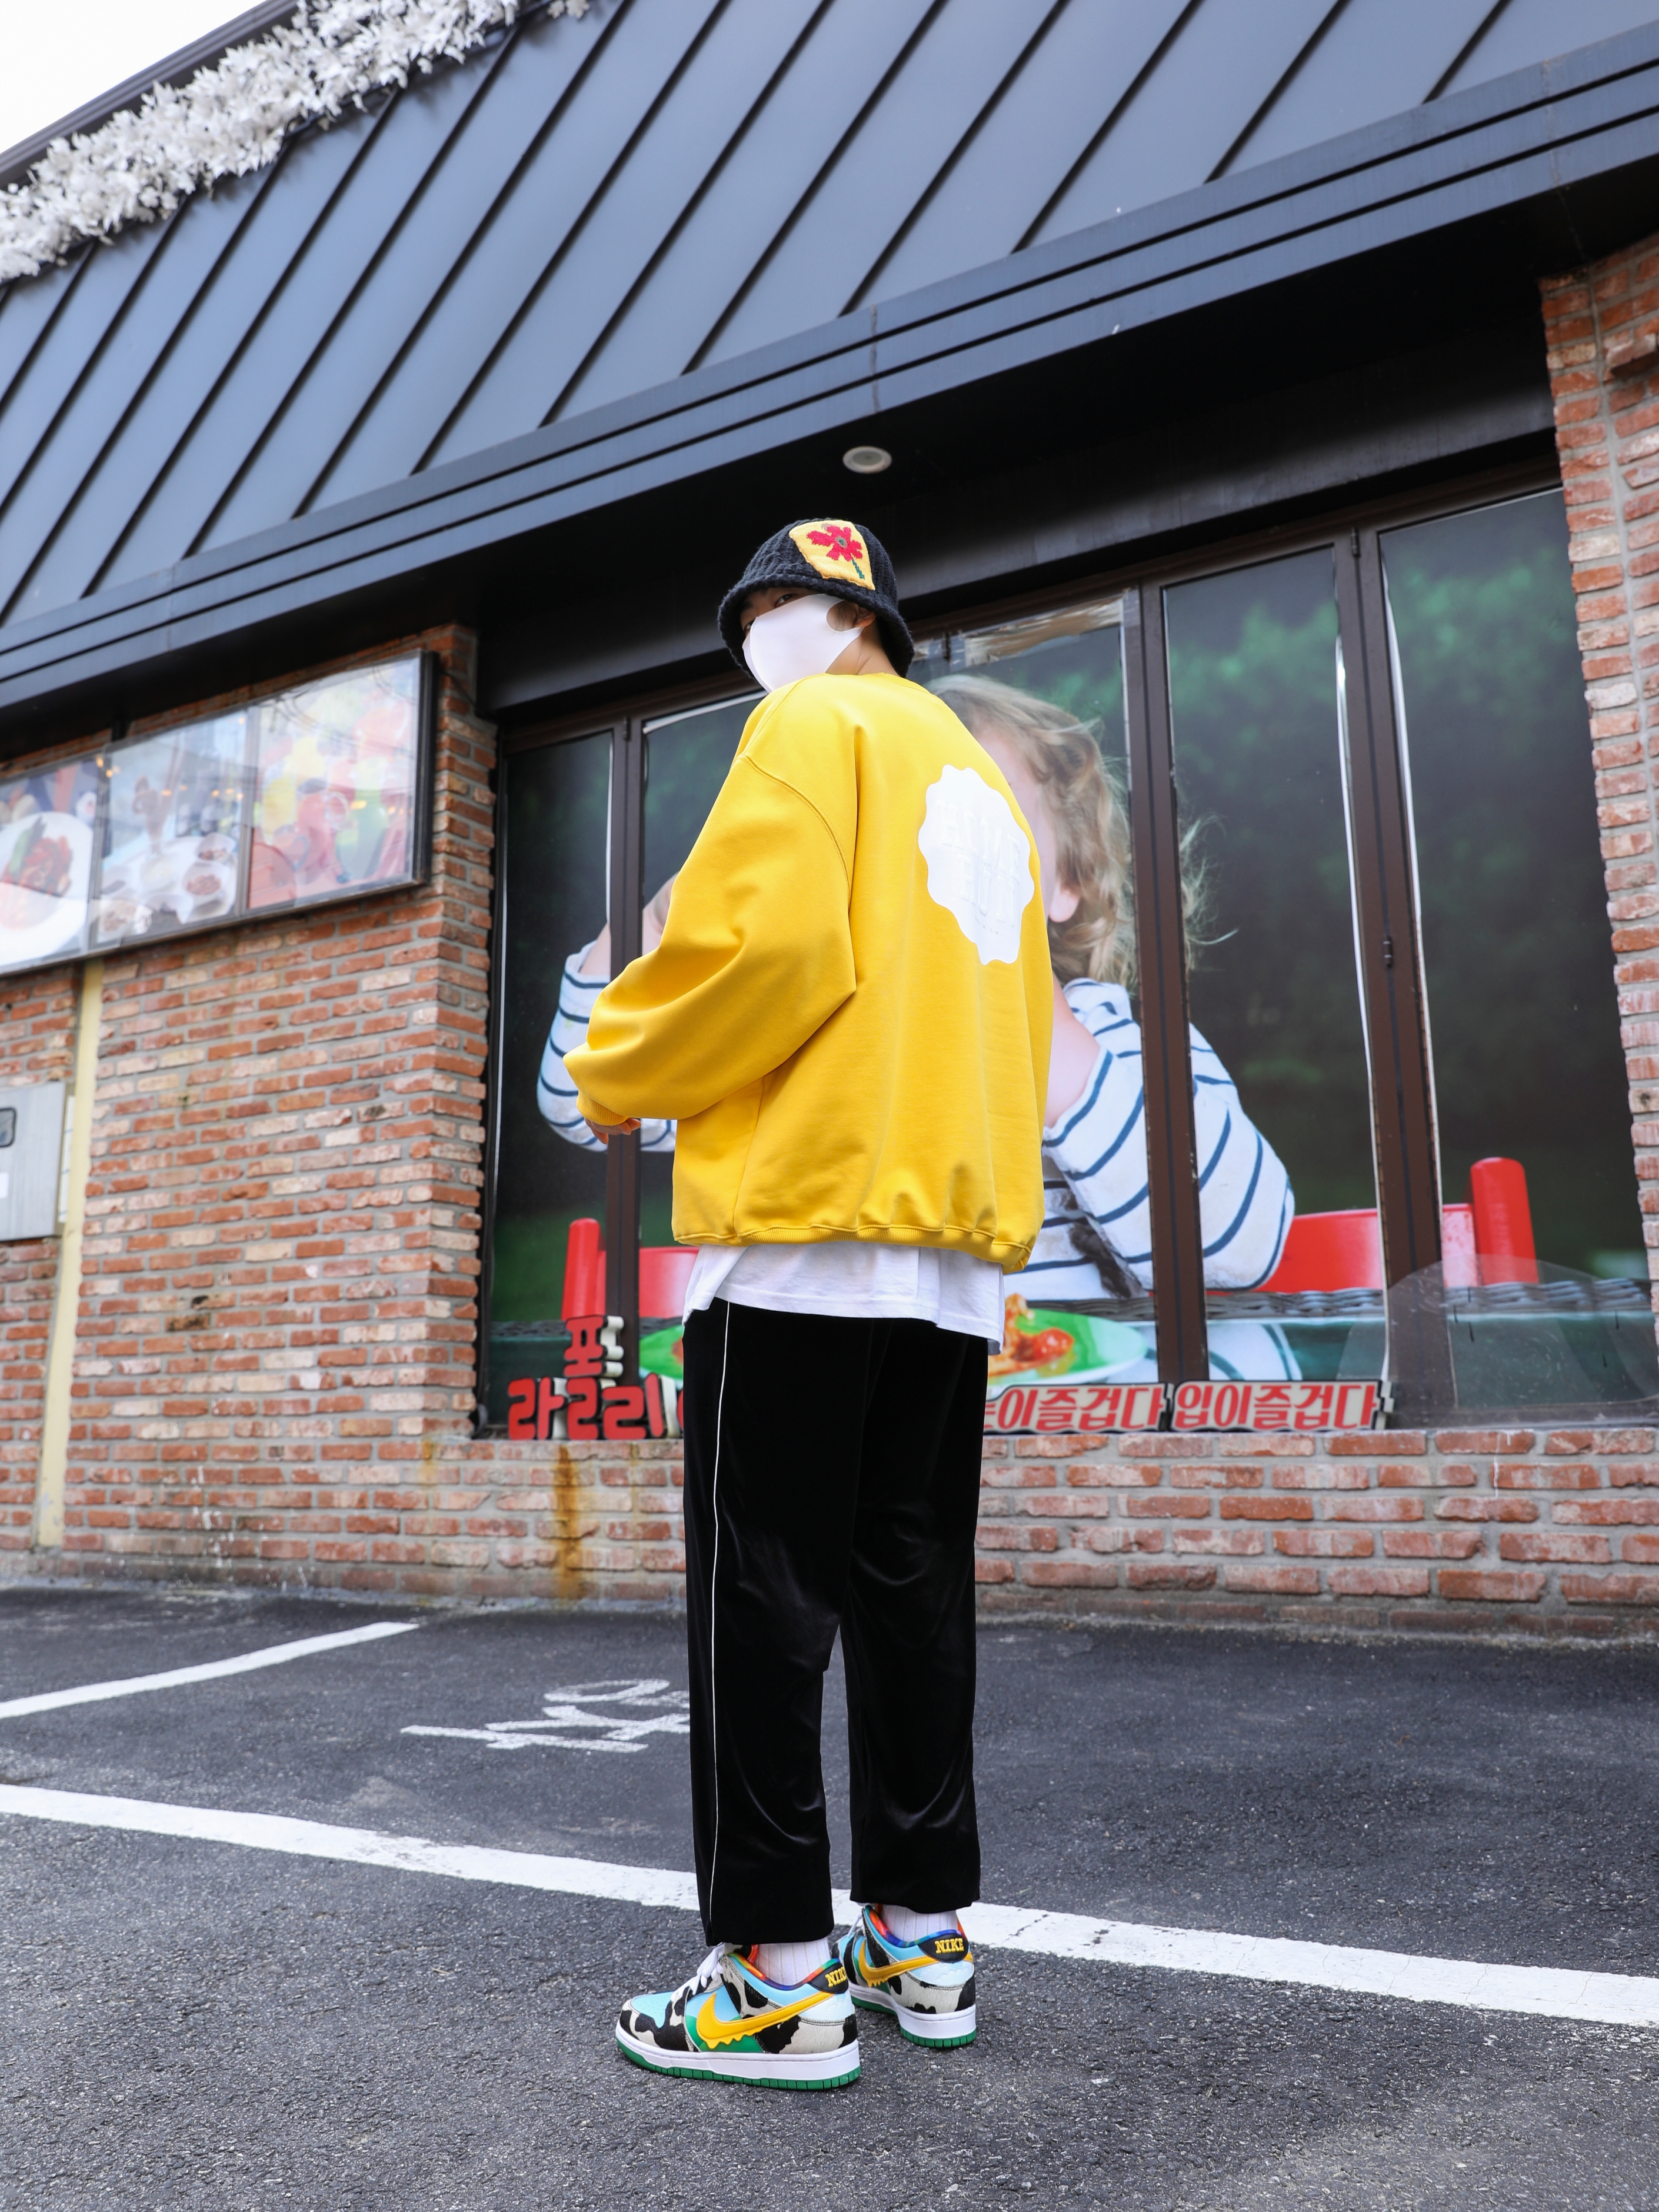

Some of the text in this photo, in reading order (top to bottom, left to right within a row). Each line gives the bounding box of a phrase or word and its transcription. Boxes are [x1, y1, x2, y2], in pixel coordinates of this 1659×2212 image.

[508, 1315, 684, 1440] 라폴리
[1174, 1384, 1378, 1430] 입이즐겁다
[934, 1938, 965, 1954] NIKE
[825, 1966, 847, 1987] NIK
